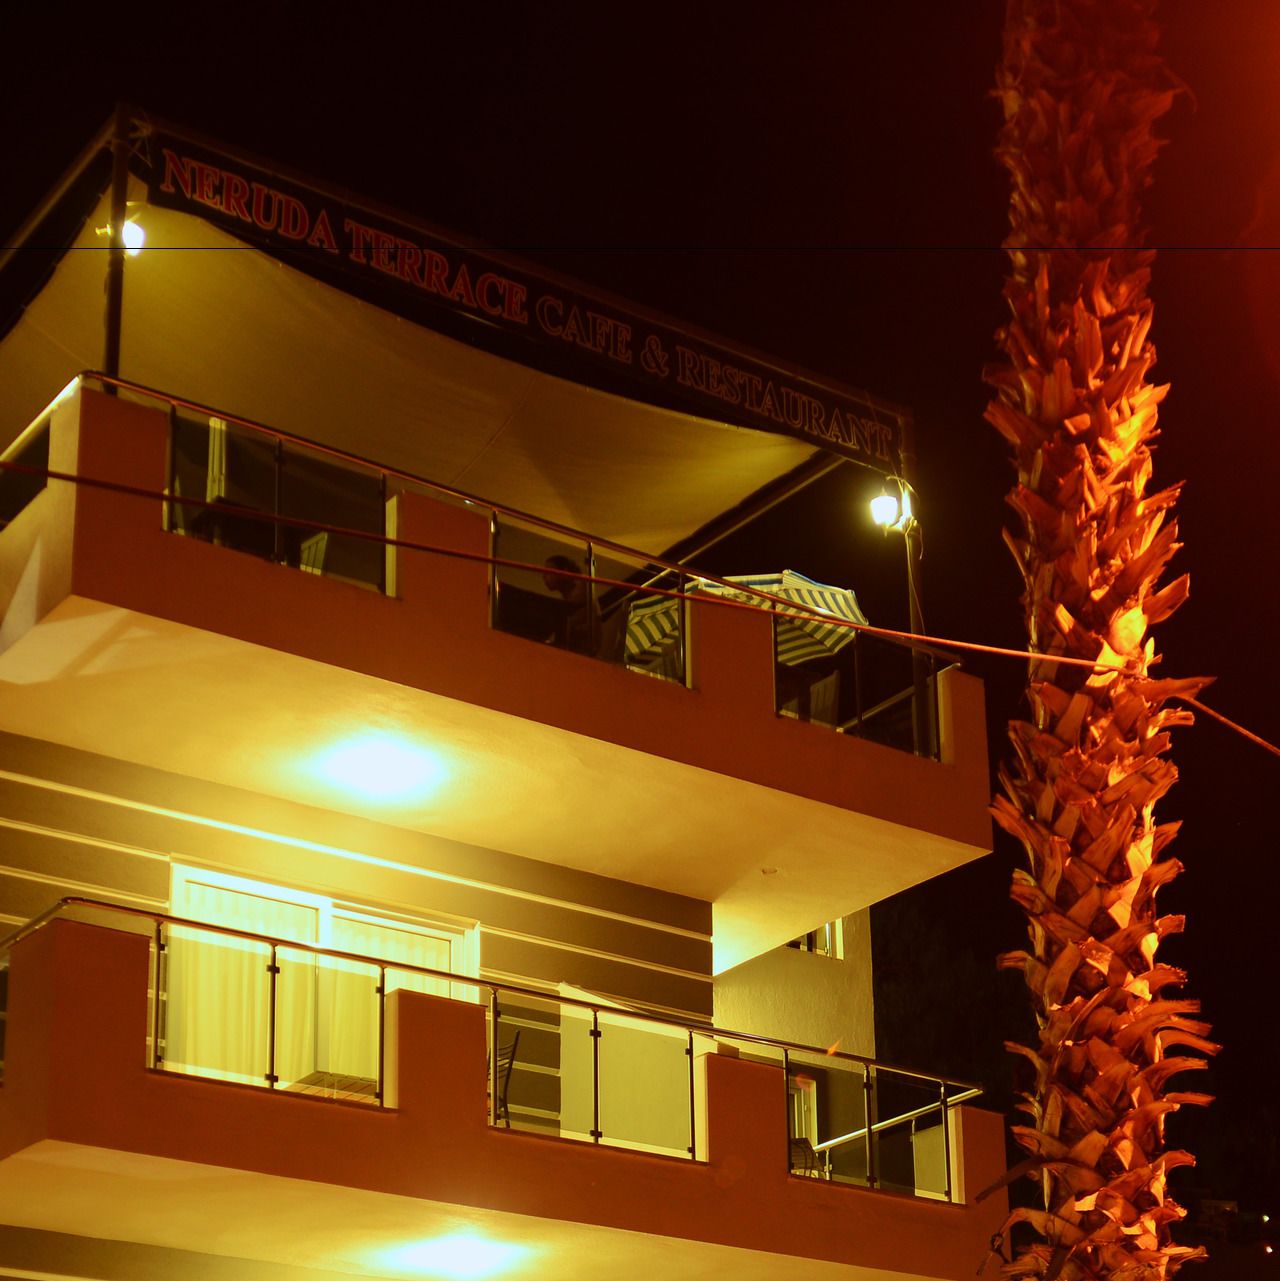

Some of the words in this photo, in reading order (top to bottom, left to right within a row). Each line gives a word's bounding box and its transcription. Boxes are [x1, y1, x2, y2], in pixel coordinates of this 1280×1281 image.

[160, 147, 339, 254] NERUDA
[344, 216, 529, 324] TERRACE
[535, 295, 632, 364] CAFE
[640, 333, 669, 377] &
[675, 345, 893, 462] RESTAURANT
